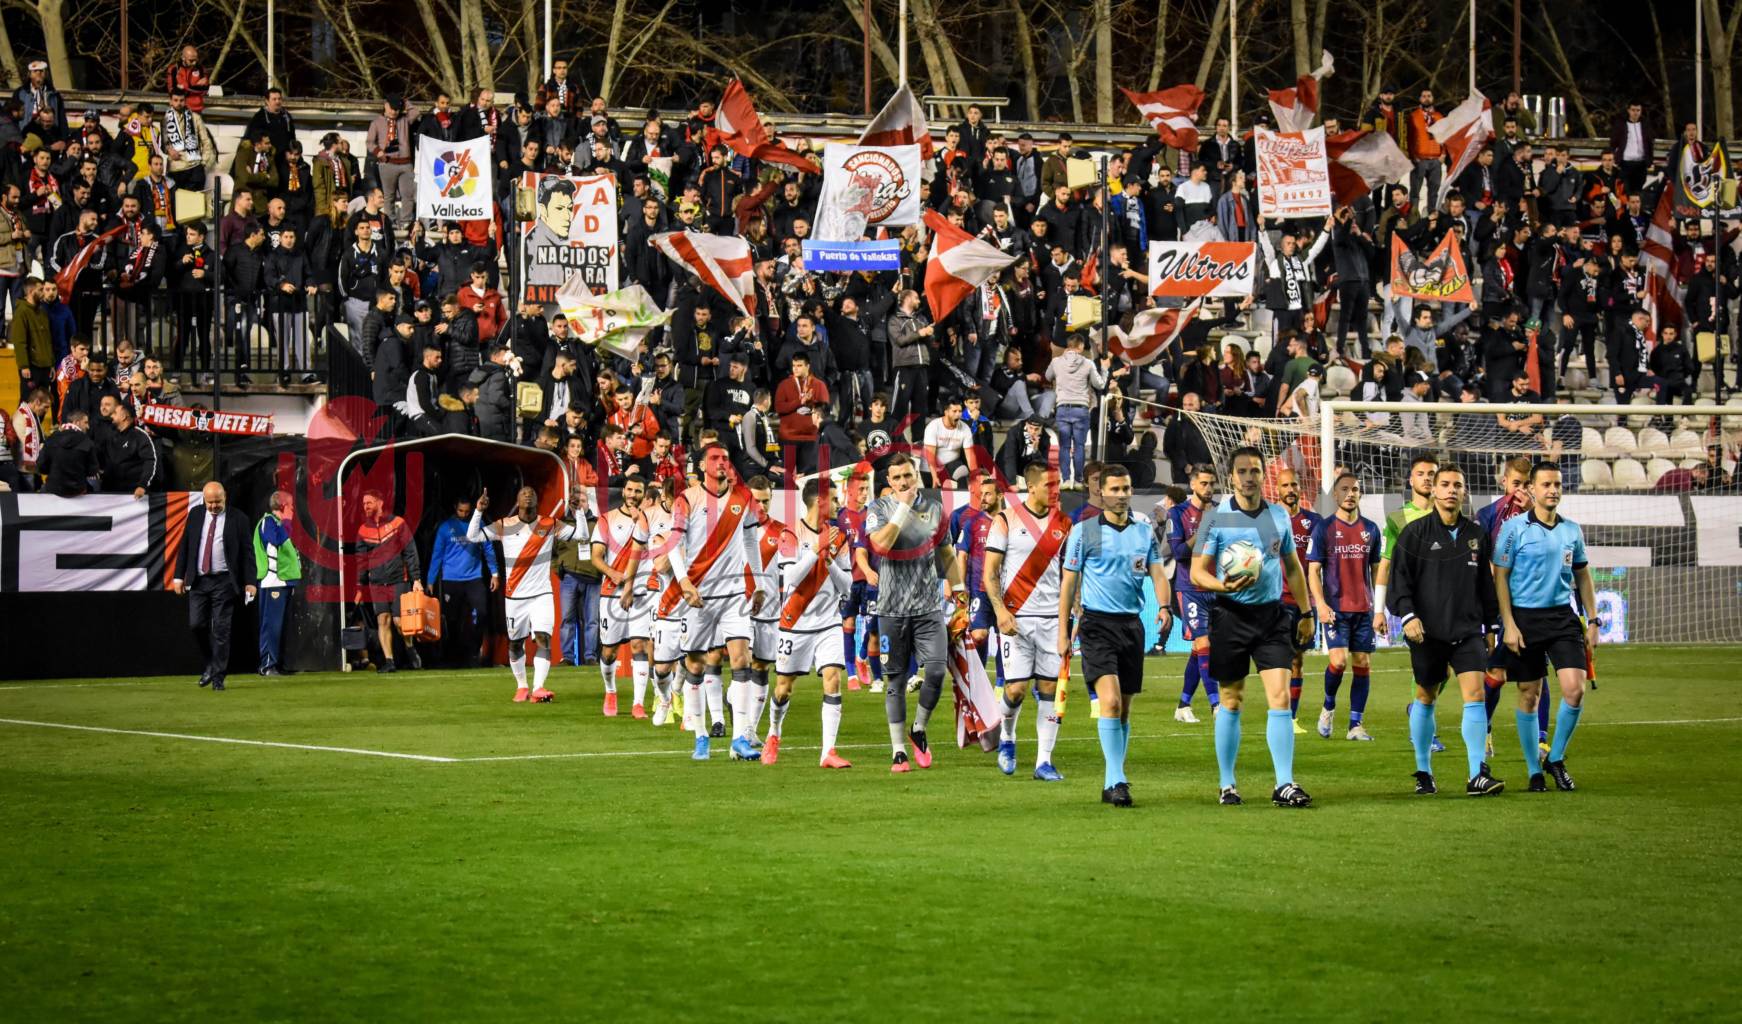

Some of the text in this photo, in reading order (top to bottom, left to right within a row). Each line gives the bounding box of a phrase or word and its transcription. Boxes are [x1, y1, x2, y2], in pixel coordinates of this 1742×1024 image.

[847, 153, 902, 182] SANCIONADOS
[431, 204, 484, 217] Vallekas
[537, 246, 609, 266] NACIDOS
[819, 250, 848, 261] Puerto
[849, 252, 860, 261] de
[1157, 249, 1250, 282] Ultras
[144, 406, 269, 434] PRESA VETE YA
[1188, 602, 1198, 618] 3
[681, 618, 688, 633] 5
[778, 638, 793, 656] 23
[1004, 641, 1010, 658] 8
